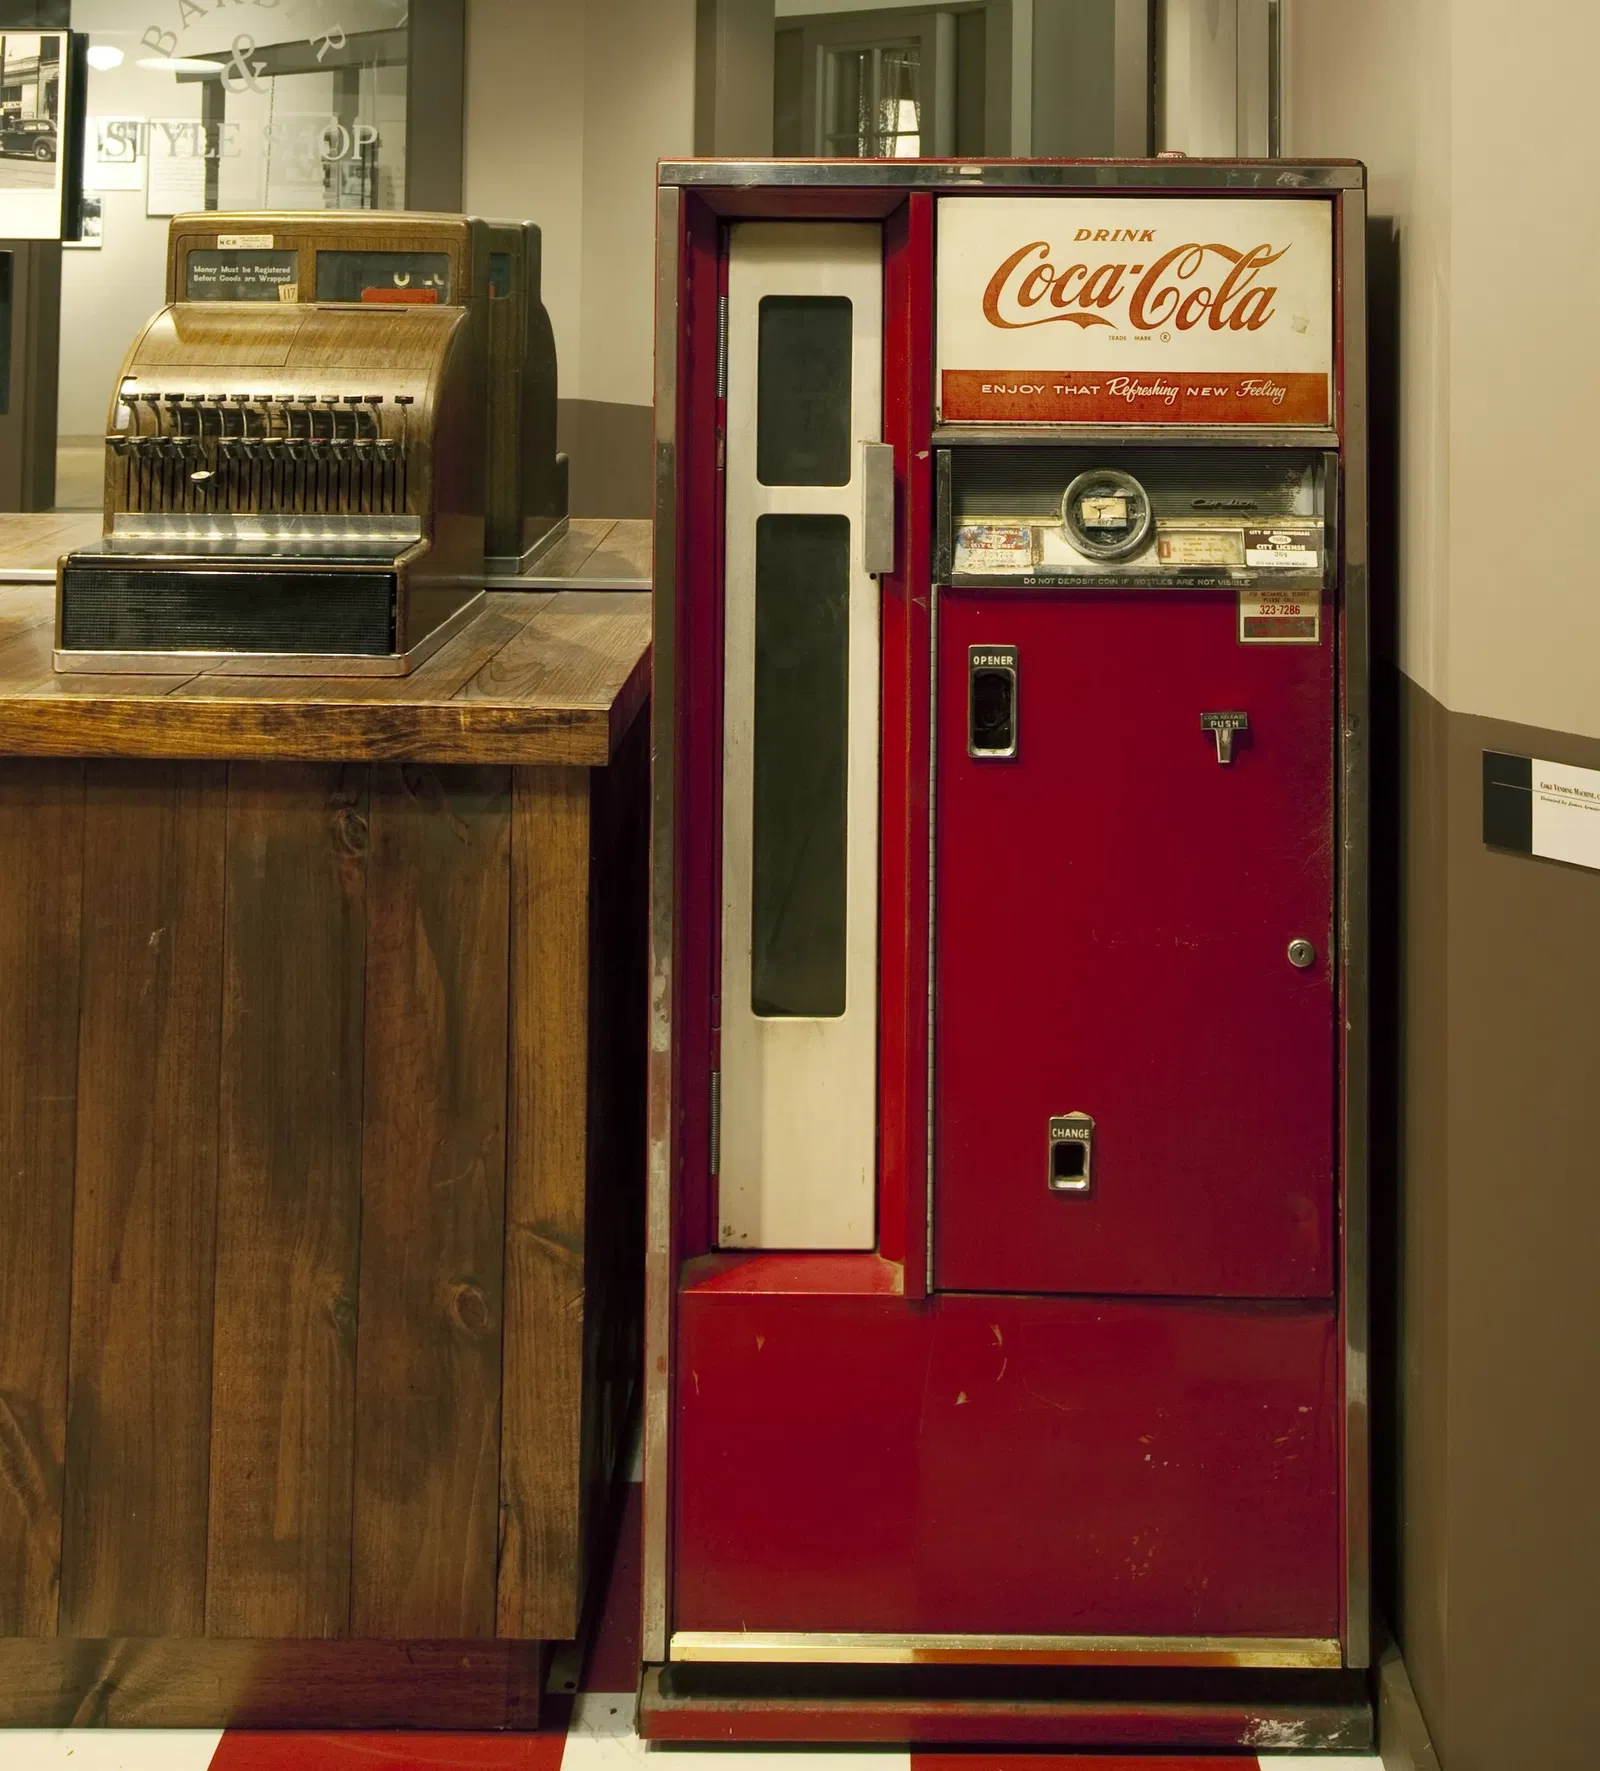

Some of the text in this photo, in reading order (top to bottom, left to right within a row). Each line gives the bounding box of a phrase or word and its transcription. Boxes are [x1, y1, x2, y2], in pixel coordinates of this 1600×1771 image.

[220, 33, 270, 94] &
[104, 121, 241, 159] STYLE
[1073, 229, 1157, 241] DRINK
[193, 266, 218, 276] Money
[254, 266, 291, 276] Registered
[193, 274, 216, 282] Before
[219, 274, 241, 282] Goods
[259, 275, 291, 284] Wrapped
[982, 241, 1292, 332] Coca-Cola
[981, 376, 1287, 406] ENJOY THAT Refreshing NEW Feeling
[1023, 577, 1036, 585] DO
[1038, 577, 1055, 585] NOT
[1057, 577, 1095, 585] DEPOSIT
[1133, 578, 1173, 586] BOTTLES
[1176, 578, 1195, 586] ARE
[1197, 578, 1215, 586] NOT
[1259, 604, 1301, 615] 323-7286
[973, 655, 1014, 665] OPENER
[1210, 720, 1239, 728] PUSH
[1052, 1128, 1090, 1139] CHANGE
